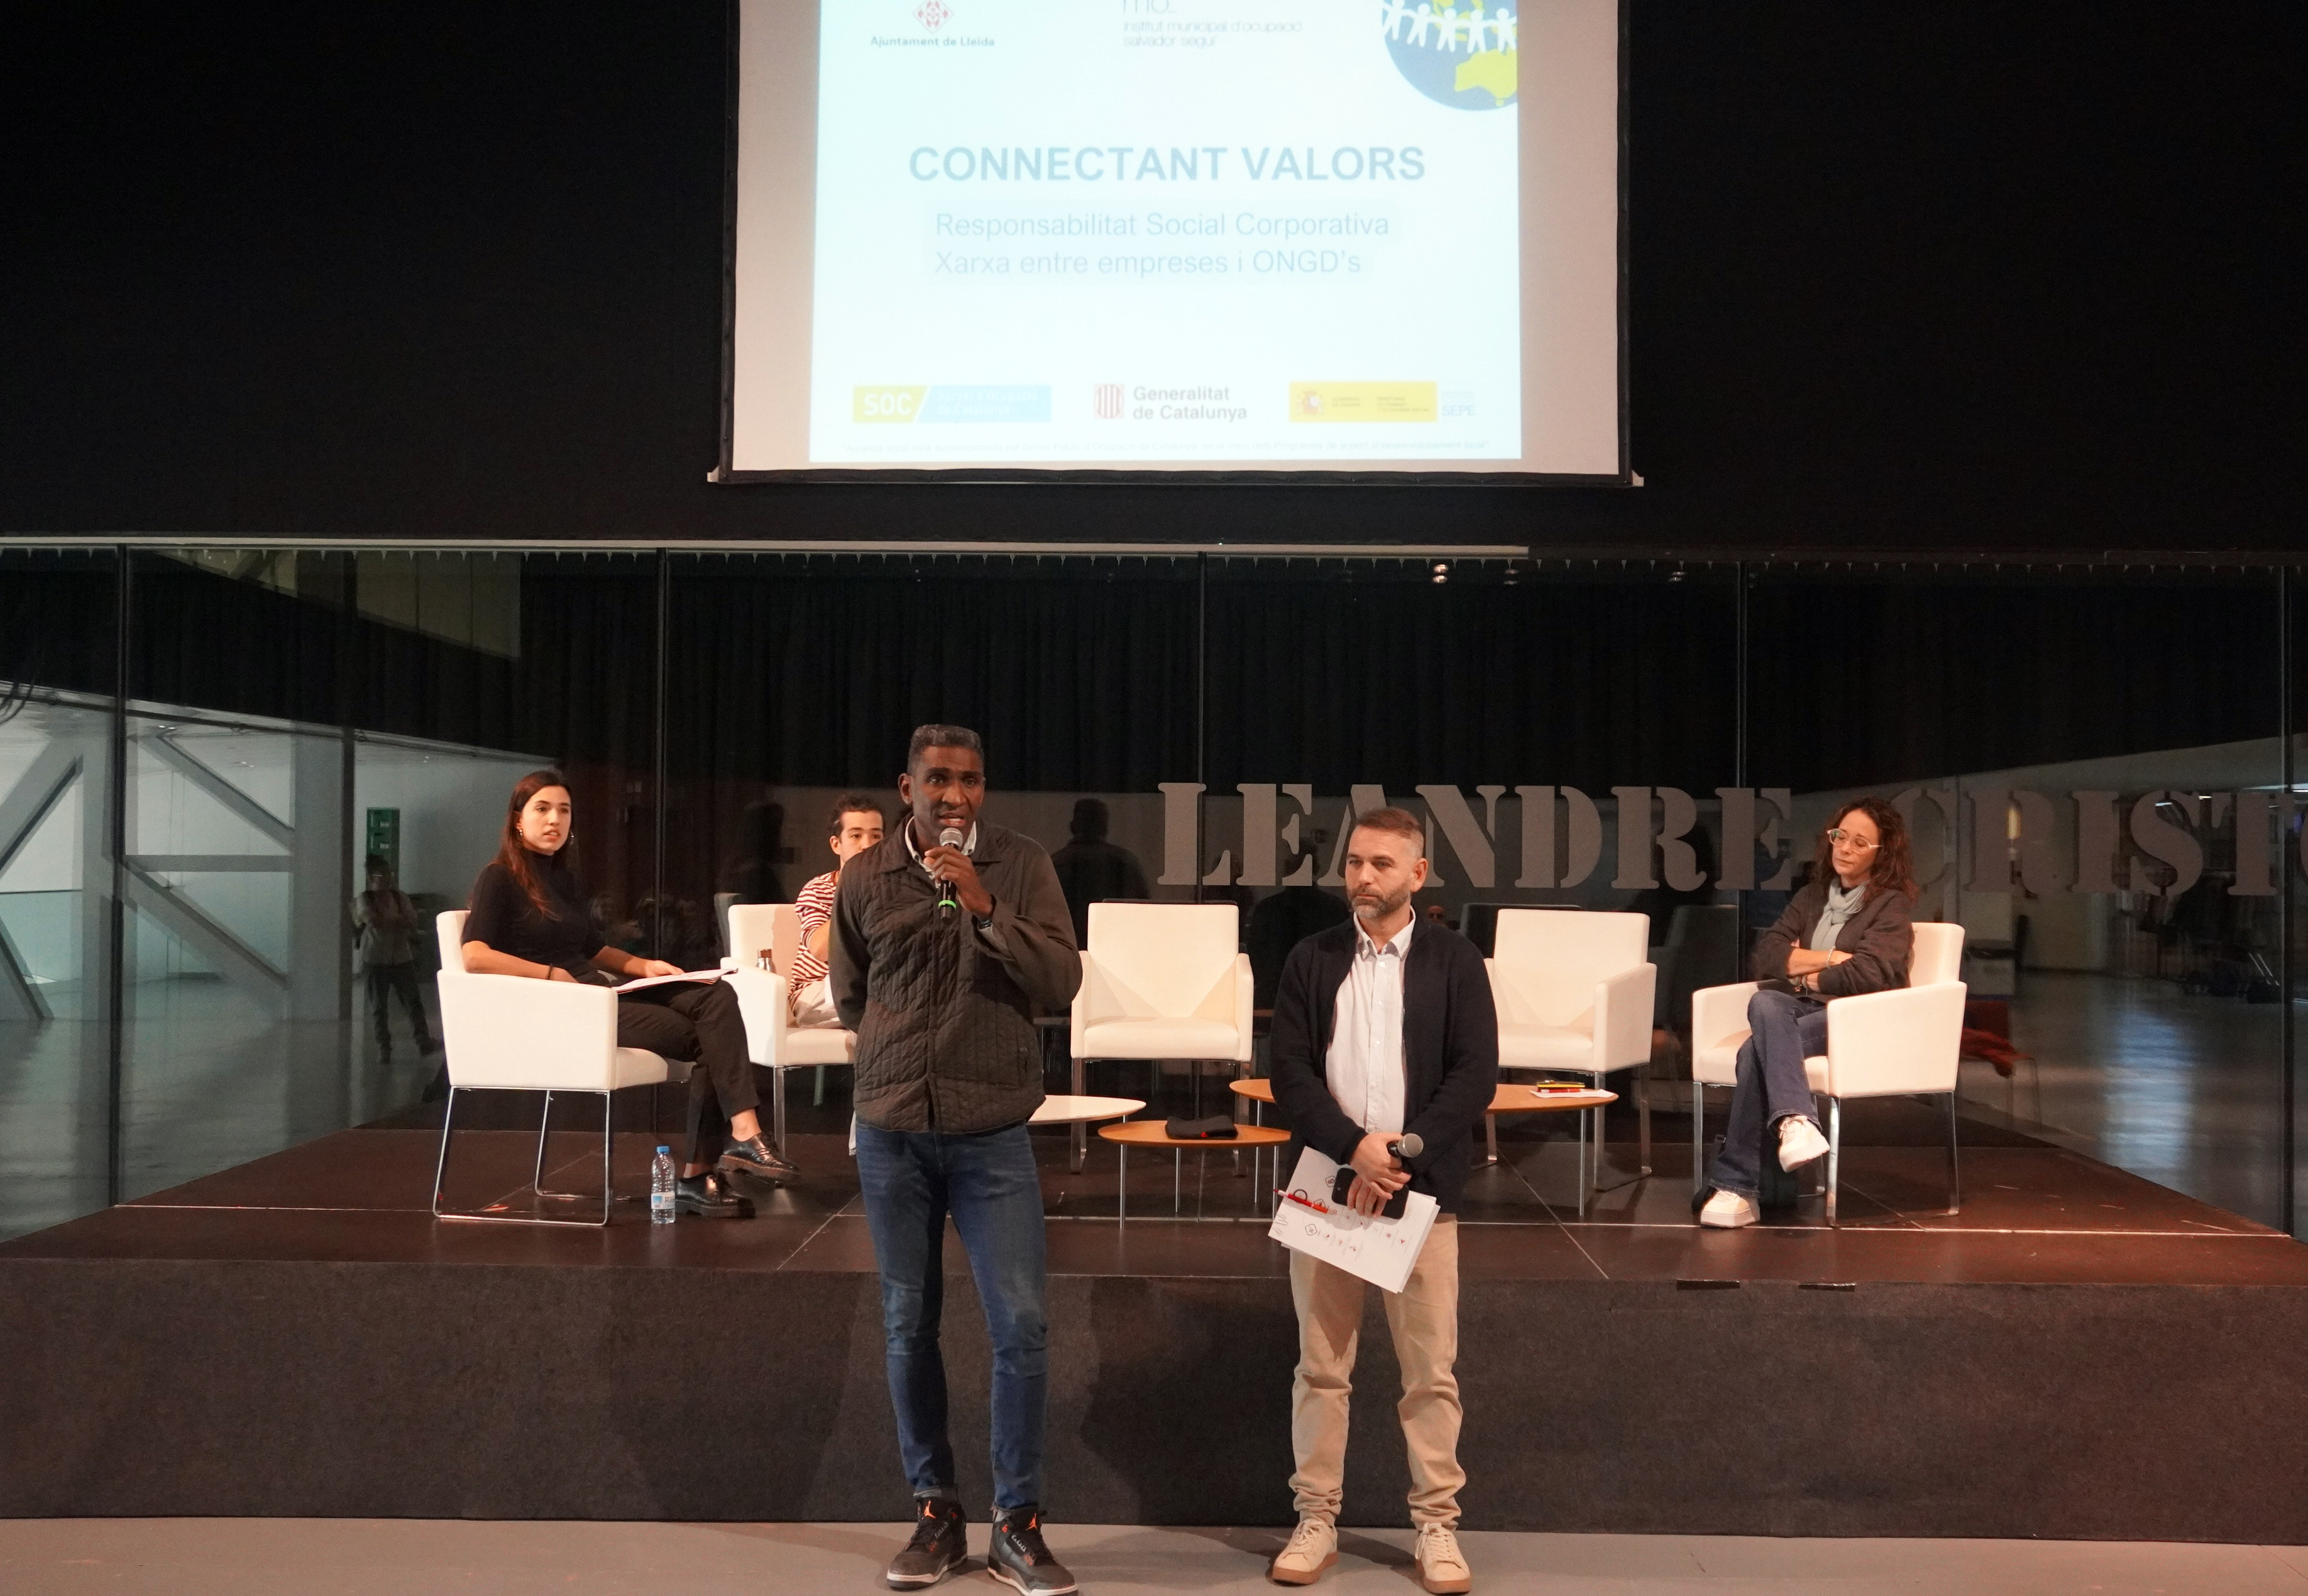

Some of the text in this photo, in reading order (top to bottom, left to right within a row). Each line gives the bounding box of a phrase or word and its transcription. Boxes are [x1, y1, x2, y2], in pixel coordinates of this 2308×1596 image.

[1123, 20, 1163, 32] institut
[1167, 20, 1227, 34] municipal
[870, 35, 995, 48] Ajuntament de Lleida
[1123, 34, 1177, 46] salvador
[909, 146, 1426, 181] CONNECTANT VALORS
[936, 212, 1389, 241] Responsabilitat Social Corporativa
[935, 249, 1361, 278] Xarxa entre empreses i ONGD's
[1133, 386, 1229, 401] Generalitat
[864, 393, 911, 416] SOC
[1133, 404, 1247, 423] de Catalunya
[1442, 405, 1475, 417] SEPE
[1157, 782, 2308, 897] LEANDRE CRIST
